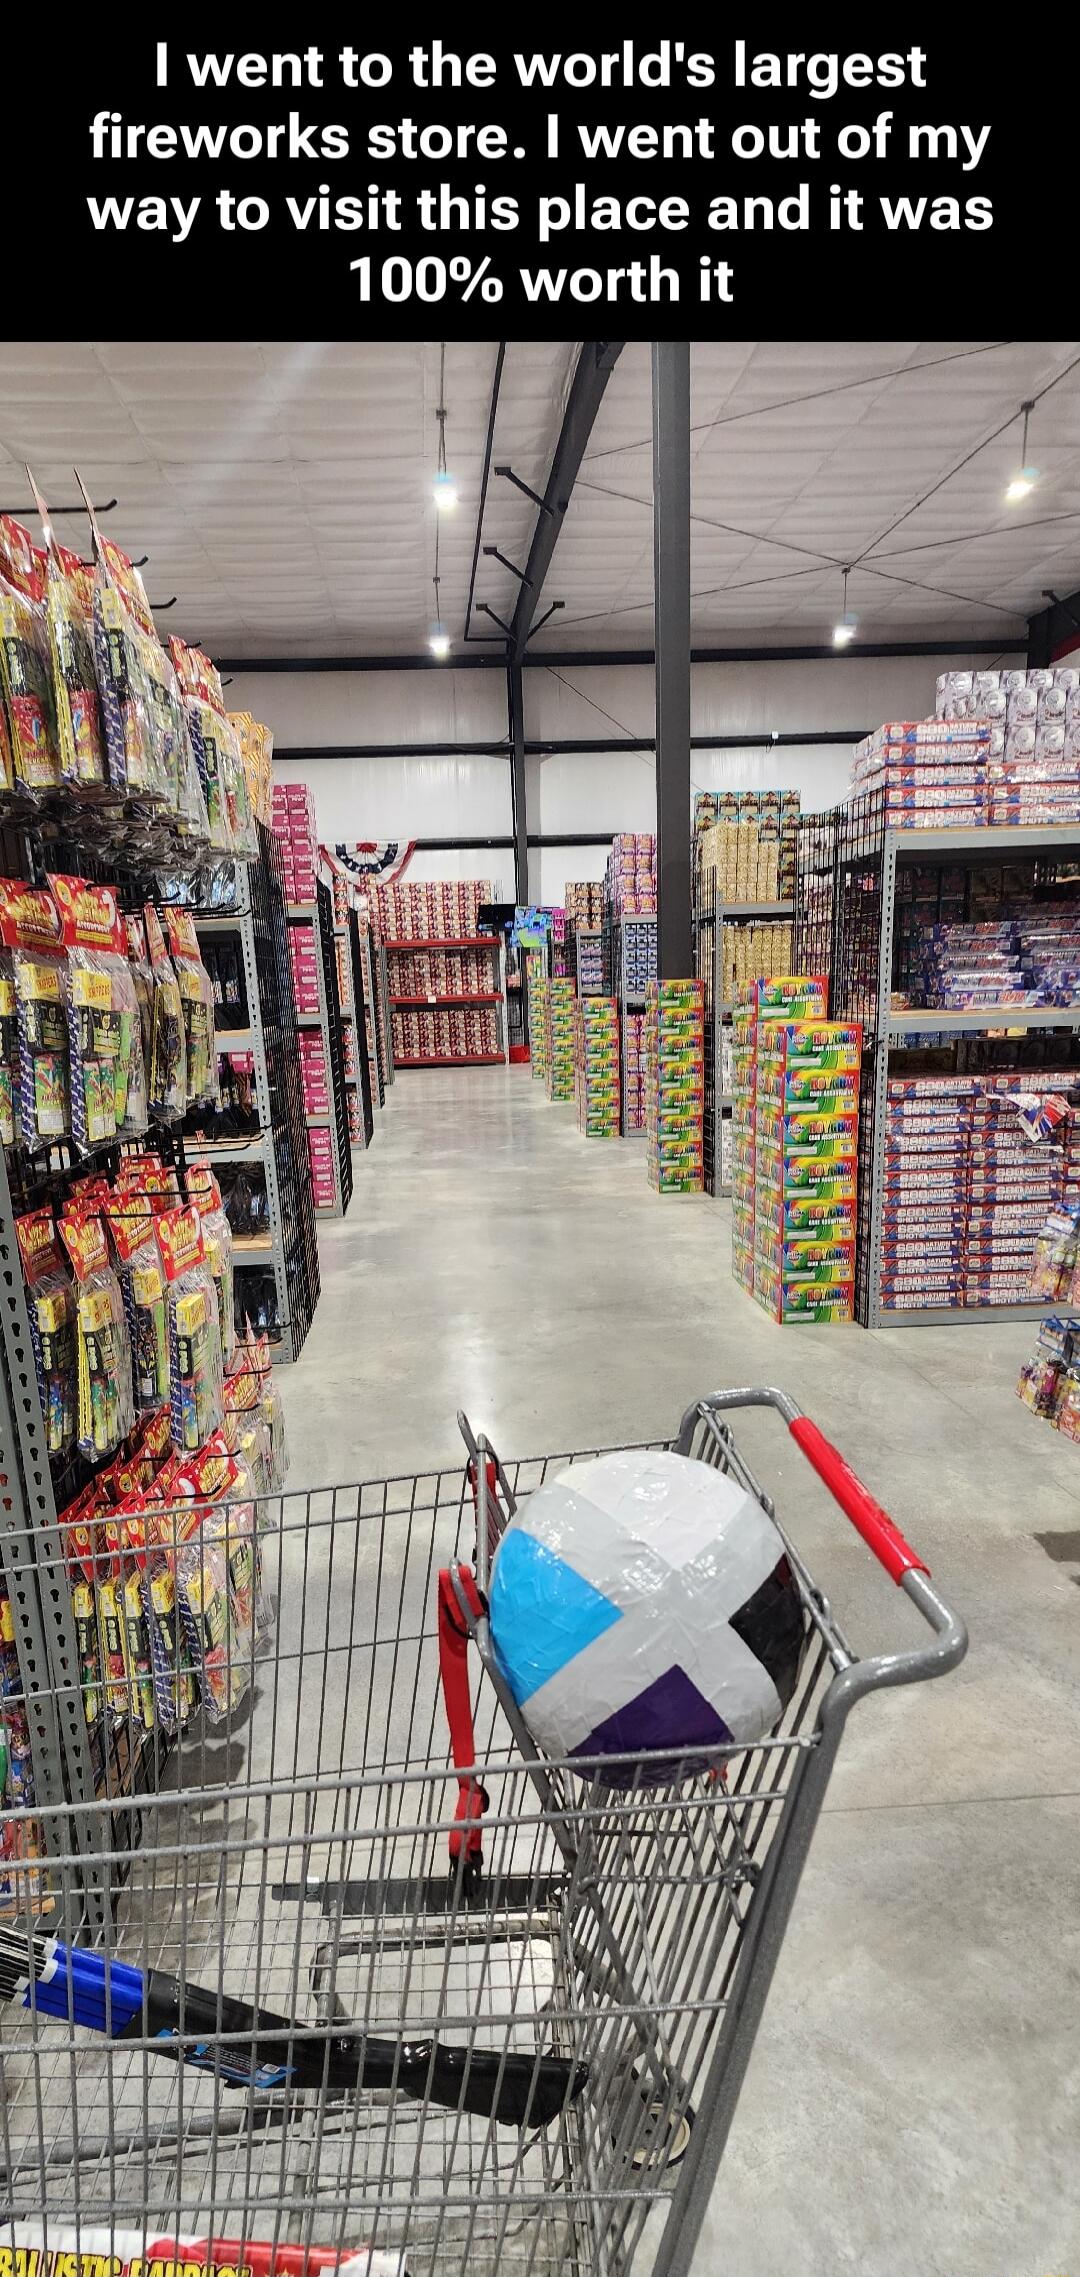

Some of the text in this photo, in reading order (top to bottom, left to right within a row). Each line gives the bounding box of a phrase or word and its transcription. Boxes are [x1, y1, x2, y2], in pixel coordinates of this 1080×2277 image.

[897, 1208, 925, 1217] 680
[898, 1224, 925, 1233] 680
[896, 1243, 924, 1252] 680
[898, 1259, 925, 1268] 680
